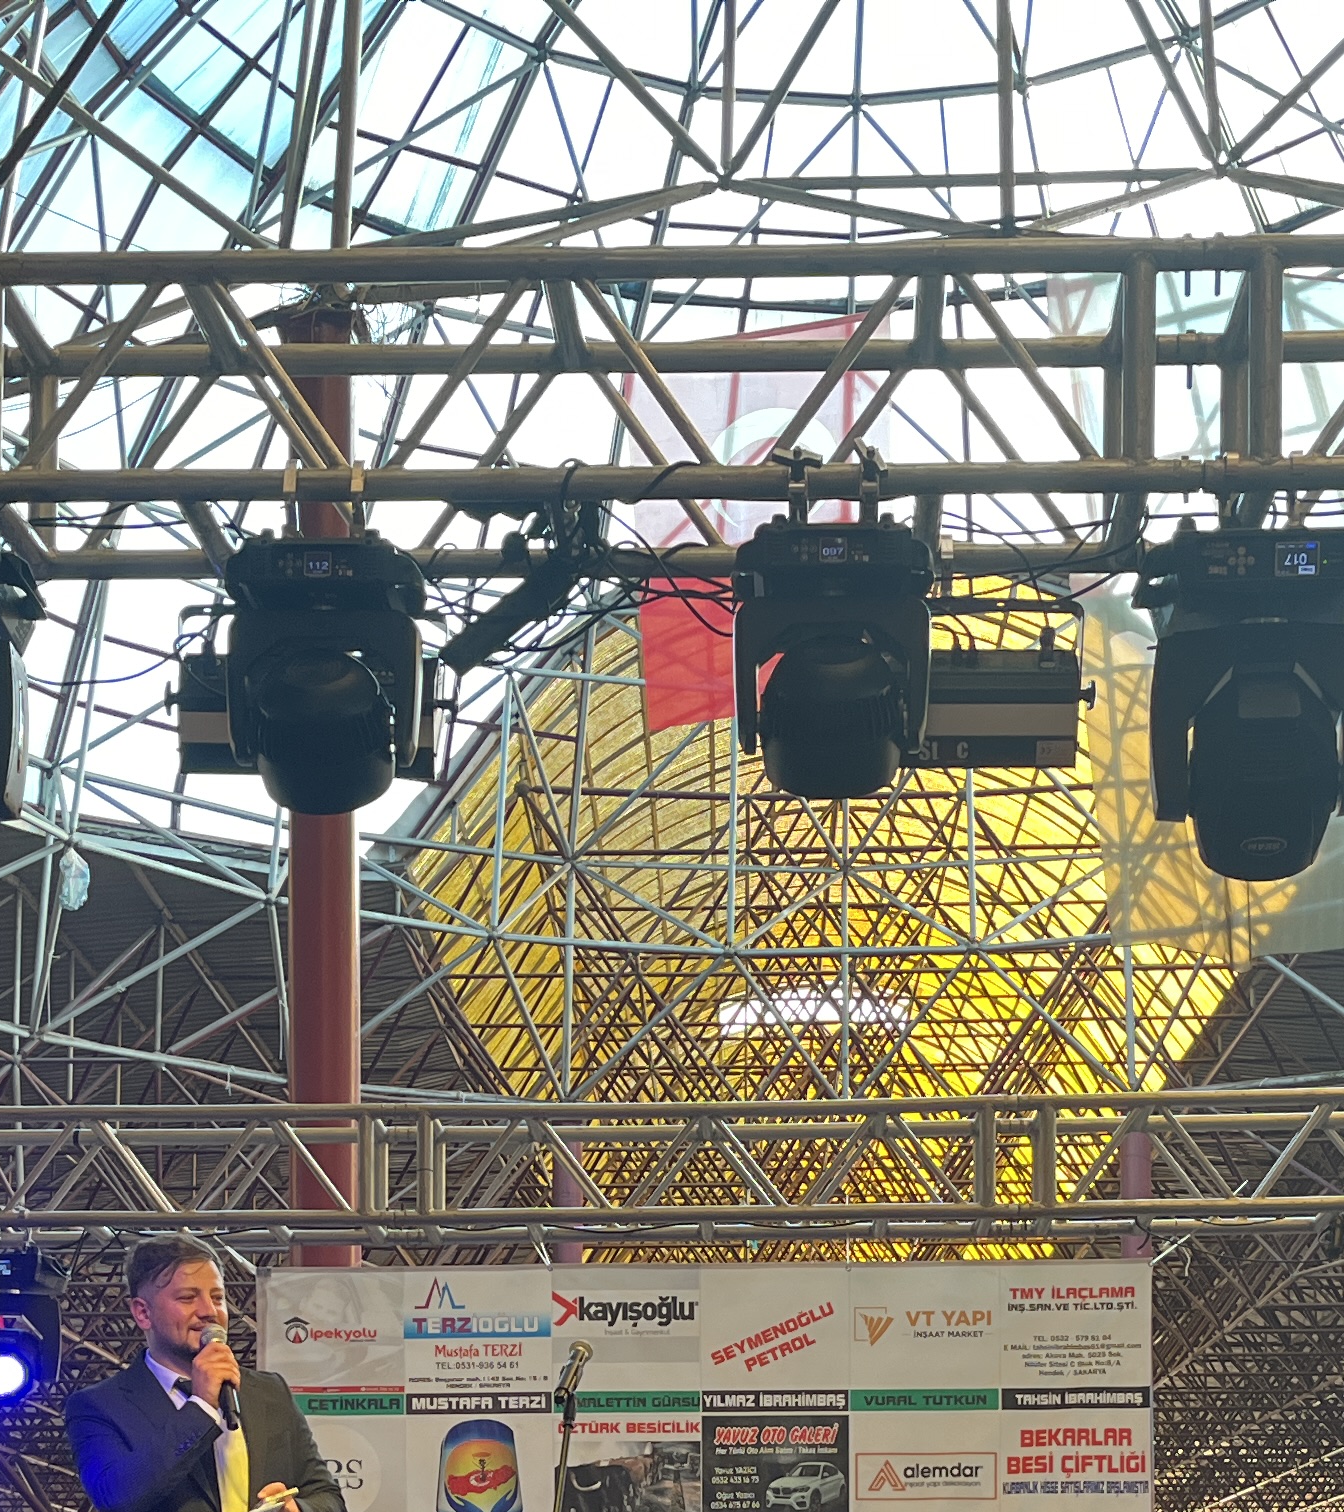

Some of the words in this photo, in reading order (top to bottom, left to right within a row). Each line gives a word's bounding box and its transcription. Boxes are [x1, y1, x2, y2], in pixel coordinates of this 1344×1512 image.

[308, 561, 329, 570] 112
[1284, 553, 1307, 566] 017
[1009, 1287, 1045, 1300] TMY
[1051, 1285, 1136, 1301] İLAÇLAMA
[579, 1296, 695, 1327] kayışoğlu
[905, 1311, 937, 1326] VT
[945, 1310, 992, 1326] YAPI
[412, 1312, 539, 1334] TERZİOĞLU
[710, 1301, 836, 1366] SEYMENOĞLU
[913, 1330, 945, 1339] İNŞAAT
[947, 1330, 984, 1338] MARKET
[435, 1344, 479, 1359] Mustafa
[483, 1342, 523, 1357] TERZİ
[744, 1332, 816, 1372] PETROL
[412, 1397, 493, 1410] MUSTAFA
[498, 1393, 546, 1409] TERZİ
[703, 1395, 755, 1407] YILMAZ
[759, 1391, 846, 1409] İBRAHİMBAŞ
[863, 1395, 917, 1406] VURAL
[922, 1394, 987, 1406] TUTKUN
[1015, 1391, 1061, 1406] TAHSİN
[1064, 1390, 1143, 1407] İBRAHİMBAŞ
[558, 1420, 620, 1434] ÖZTÜRK
[626, 1419, 700, 1434] BESİCİLİK
[714, 1426, 759, 1445] YAVUZ
[761, 1426, 787, 1445] OTO
[789, 1422, 839, 1445] GALERİ
[1020, 1428, 1132, 1447] BEKARLAR
[903, 1463, 980, 1478] alemdar
[1007, 1451, 1053, 1474] BESİ
[1061, 1451, 1146, 1478] ÇİFTLİĞİ
